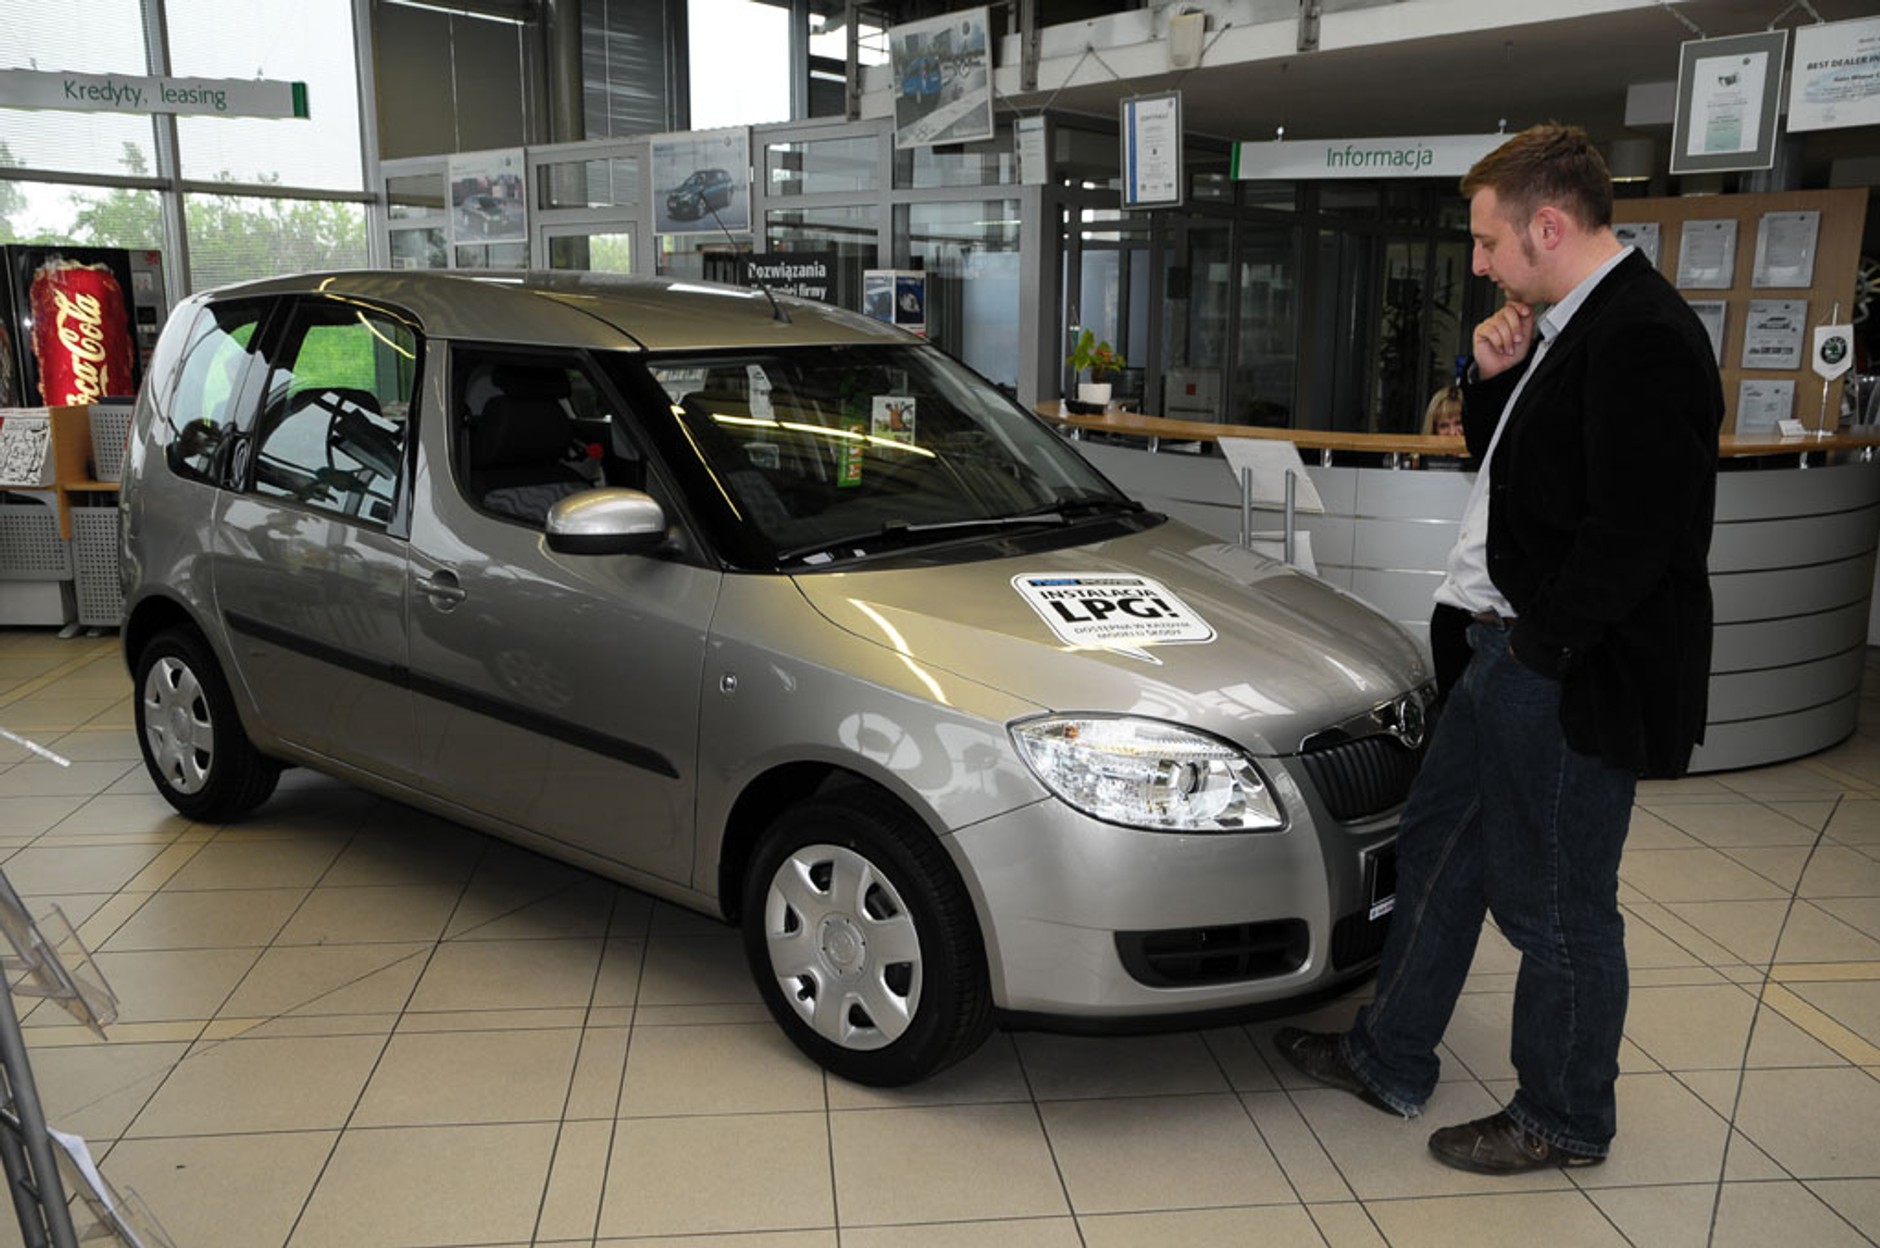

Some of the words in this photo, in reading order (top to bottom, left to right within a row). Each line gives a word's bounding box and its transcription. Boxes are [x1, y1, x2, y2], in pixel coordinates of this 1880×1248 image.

[1806, 59, 1830, 71] BEST
[1831, 55, 1867, 68] DEALER
[64, 80, 148, 107] Kredyty,
[160, 83, 227, 111] leasing
[1327, 143, 1433, 171] Informacja
[799, 283, 827, 301] firmy
[1040, 589, 1158, 600] INSTALACJA
[1050, 598, 1180, 623] LPG!
